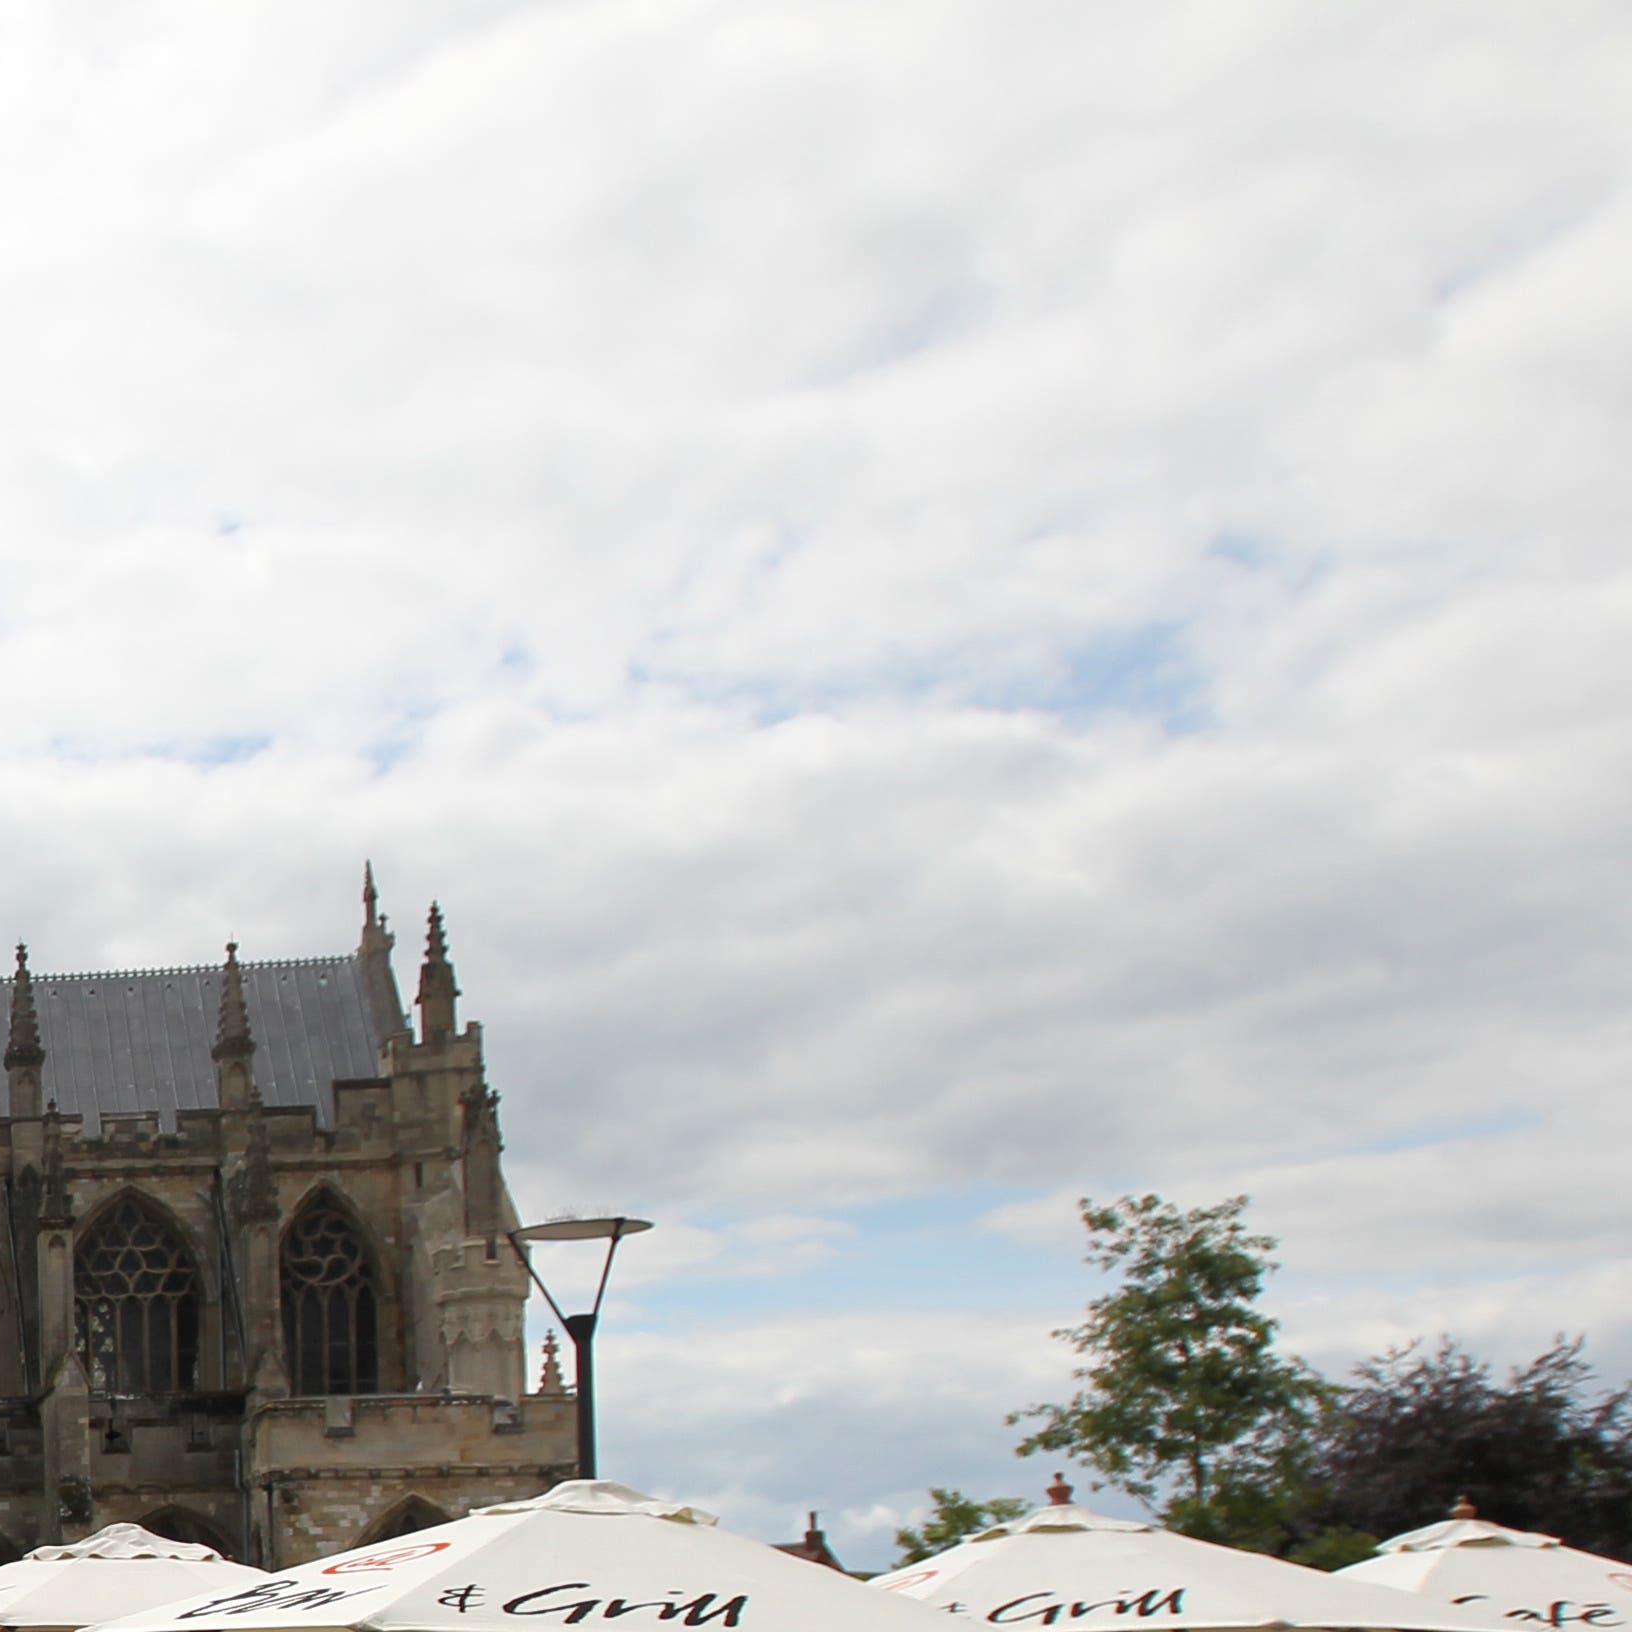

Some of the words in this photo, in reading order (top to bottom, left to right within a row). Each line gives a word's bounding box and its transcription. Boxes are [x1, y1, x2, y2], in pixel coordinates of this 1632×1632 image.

[175, 1580, 388, 1619] Bar
[503, 1583, 752, 1627] Grill
[986, 1588, 1187, 1625] Grill
